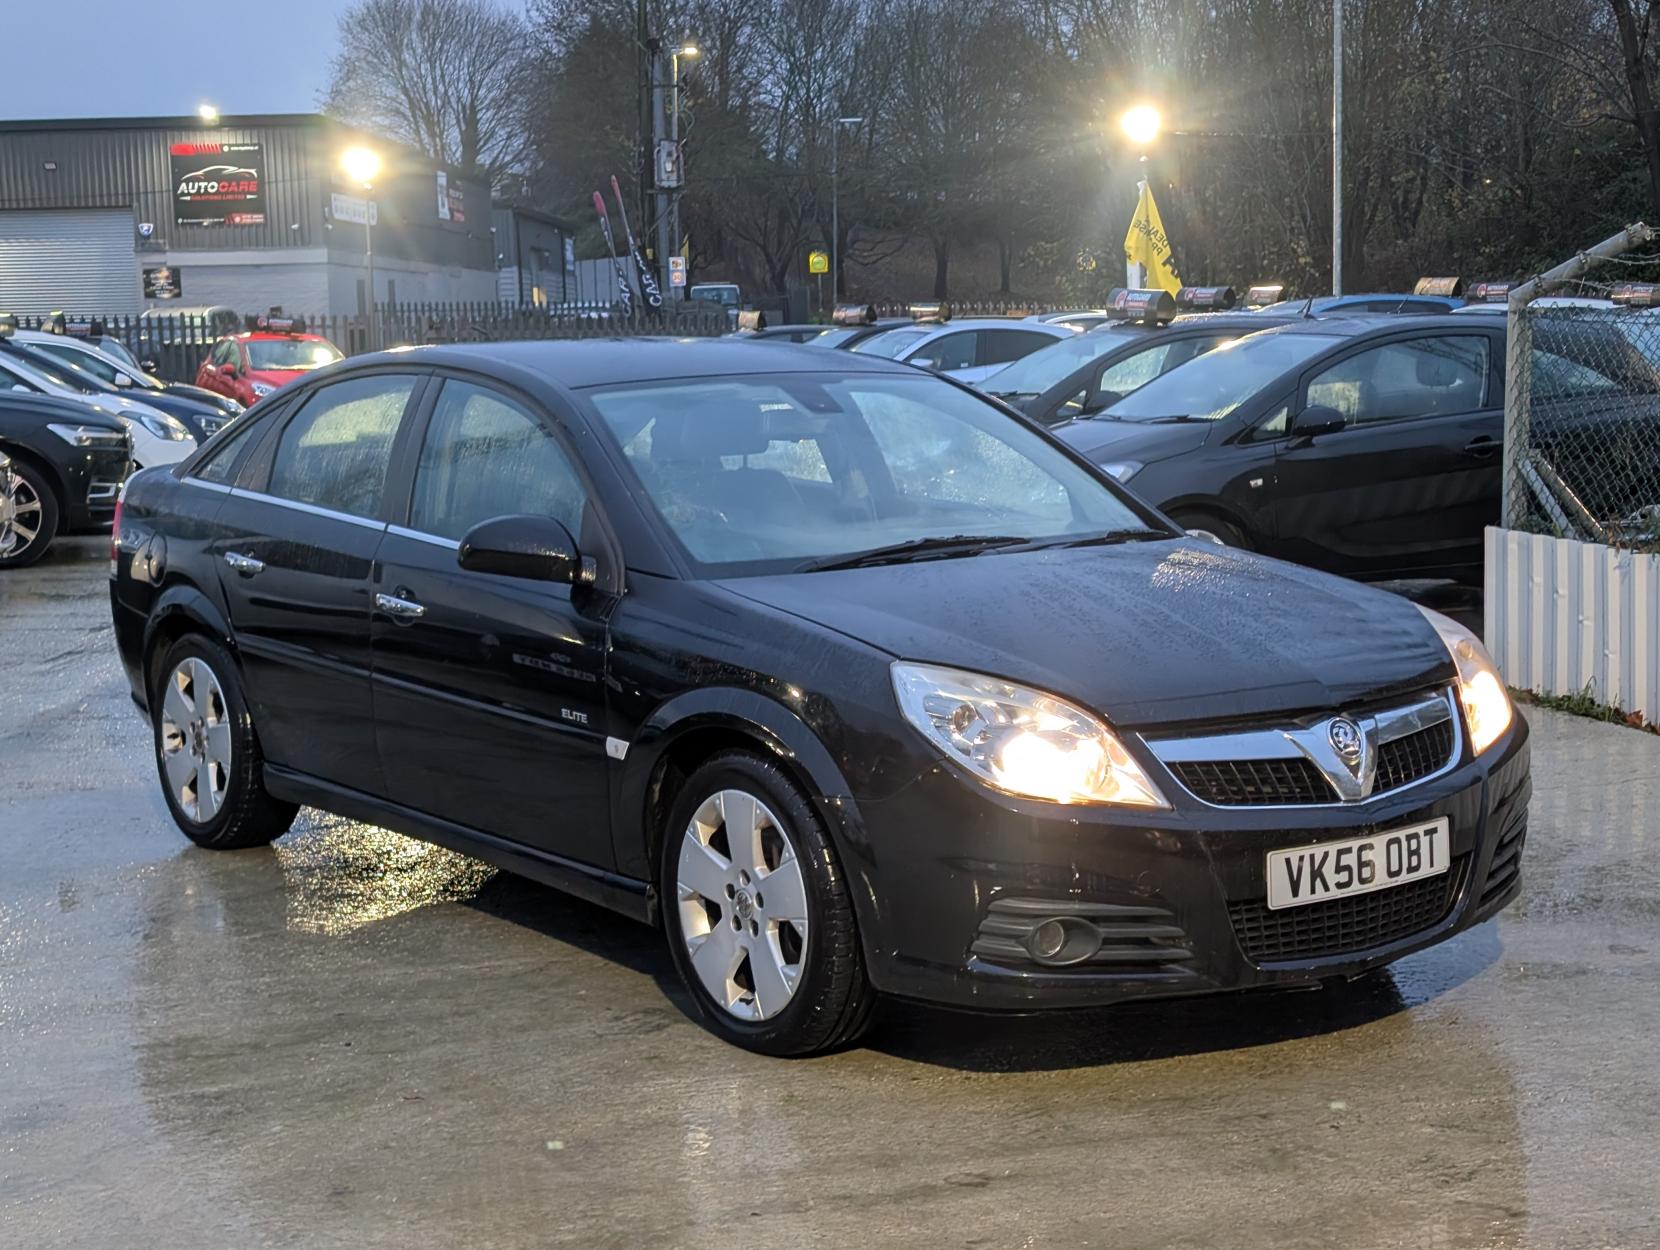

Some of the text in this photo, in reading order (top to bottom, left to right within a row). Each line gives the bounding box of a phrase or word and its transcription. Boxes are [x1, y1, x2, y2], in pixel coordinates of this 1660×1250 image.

[177, 181, 258, 194] AUTOCARE
[561, 708, 588, 724] ELITE
[1284, 827, 1438, 898] VK56 OBT
